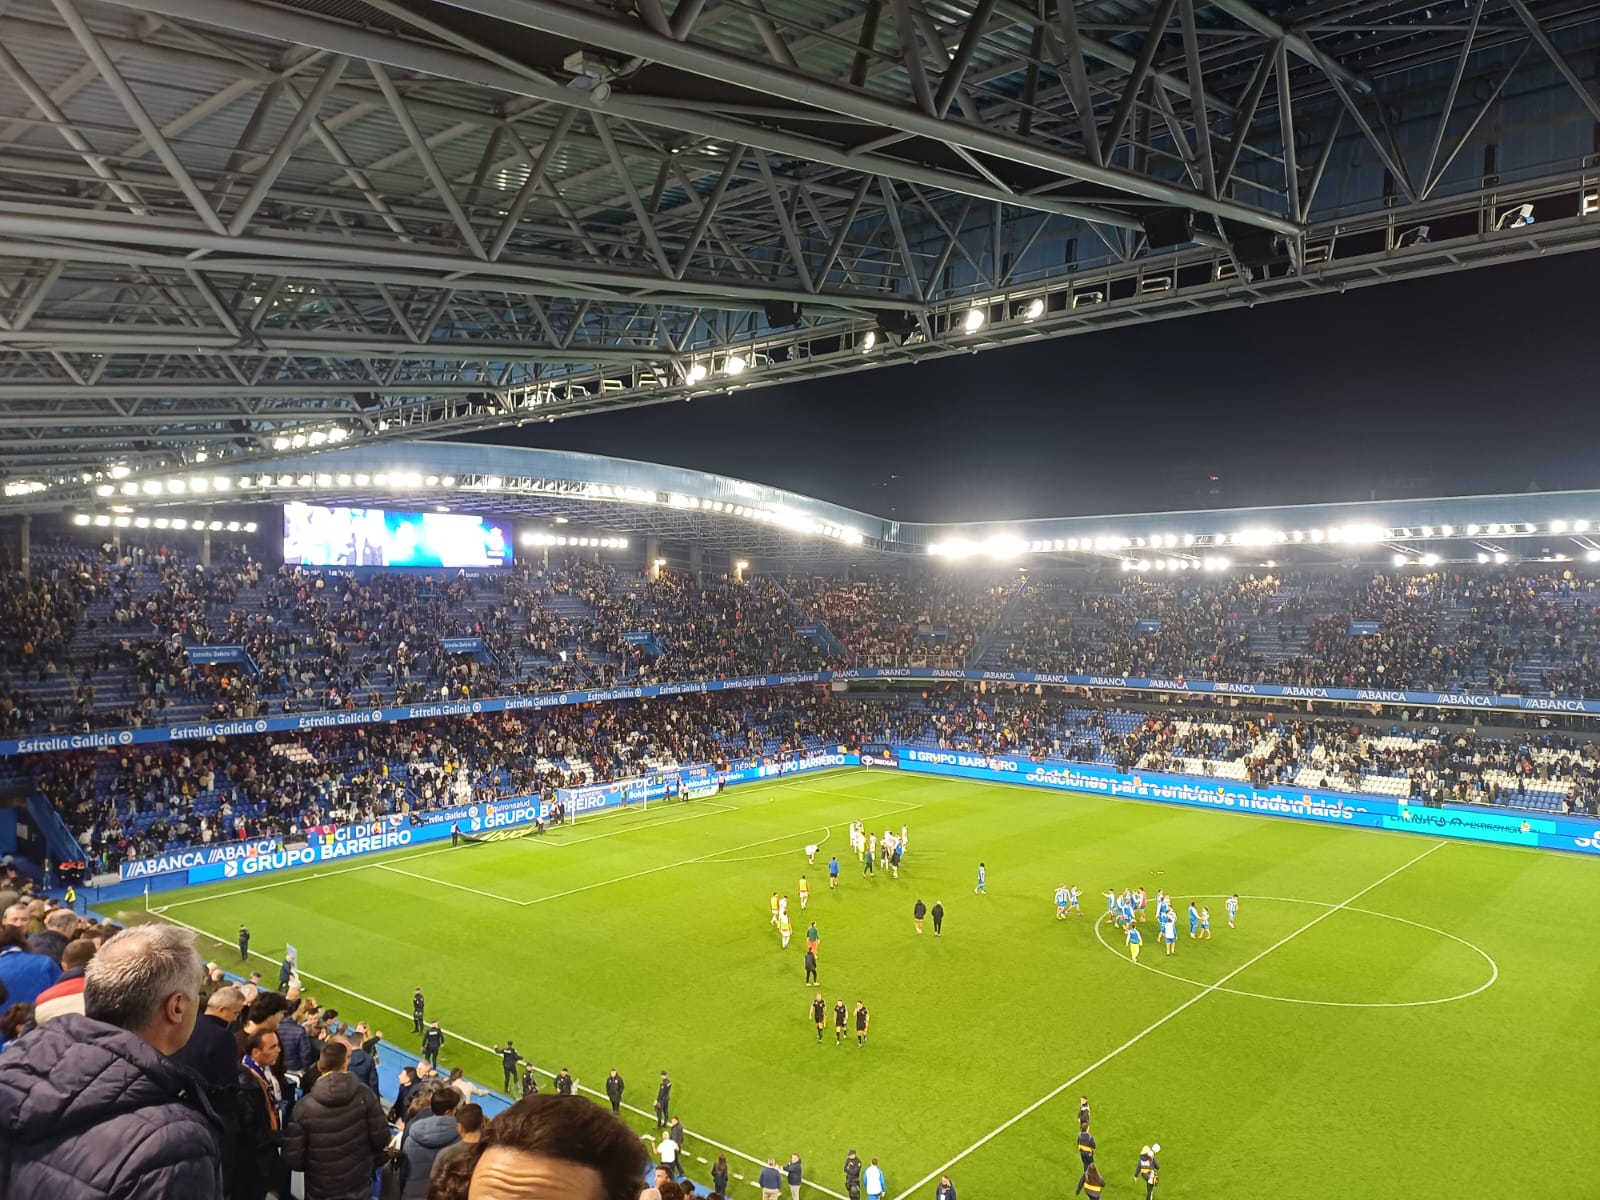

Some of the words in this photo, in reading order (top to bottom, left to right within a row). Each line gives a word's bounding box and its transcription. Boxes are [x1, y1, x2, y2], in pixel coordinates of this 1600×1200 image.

[505, 698, 533, 710] Estrella
[533, 696, 559, 707] Galicia
[587, 691, 612, 701] Estrella
[612, 689, 635, 699] Galicia
[409, 706, 442, 718] Estrella
[442, 703, 471, 717] Galicia
[298, 714, 336, 728] Estrella
[337, 711, 371, 725] Galicia
[169, 723, 213, 739] Estrella
[213, 721, 253, 736] Galicia
[16, 737, 69, 753] Estrella
[70, 734, 116, 748] Galicia
[484, 806, 536, 829] GRUPO
[242, 848, 316, 875] GRUPO
[319, 829, 412, 860] BARREIRO
